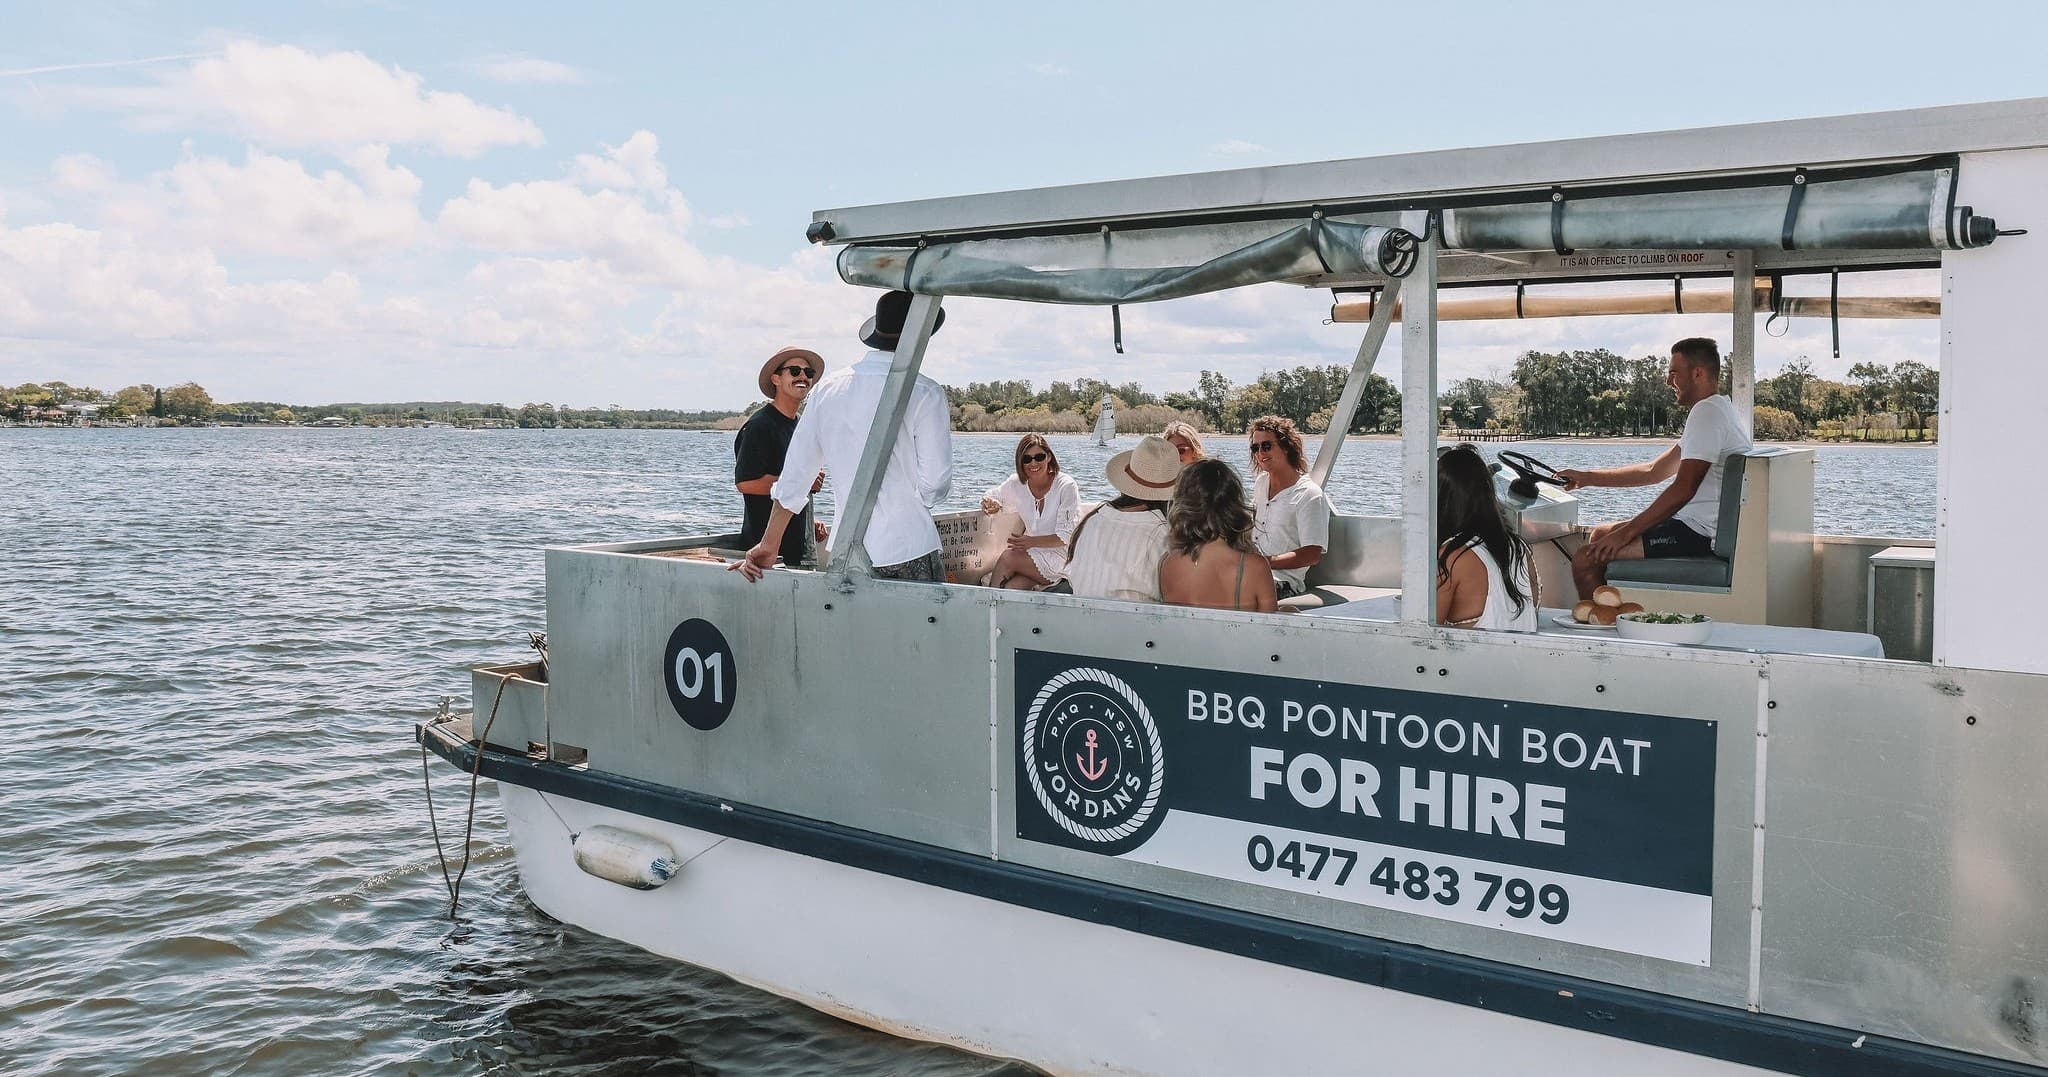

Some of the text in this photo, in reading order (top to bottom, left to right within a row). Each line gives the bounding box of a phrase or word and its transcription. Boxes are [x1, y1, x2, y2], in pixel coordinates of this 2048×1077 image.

[1560, 253, 1705, 267] IT IS AN OFFENCE TO CLIMB ON ROOF
[935, 520, 951, 535] ffence
[675, 647, 723, 704] 01
[1051, 704, 1134, 750] PMQ NSW
[1187, 688, 1652, 776] BBQ PONTOON BOAT
[1044, 761, 1141, 819] JORDANS
[1250, 745, 1566, 846] FOR HIRE
[1247, 834, 1570, 925] 0477 483 799
